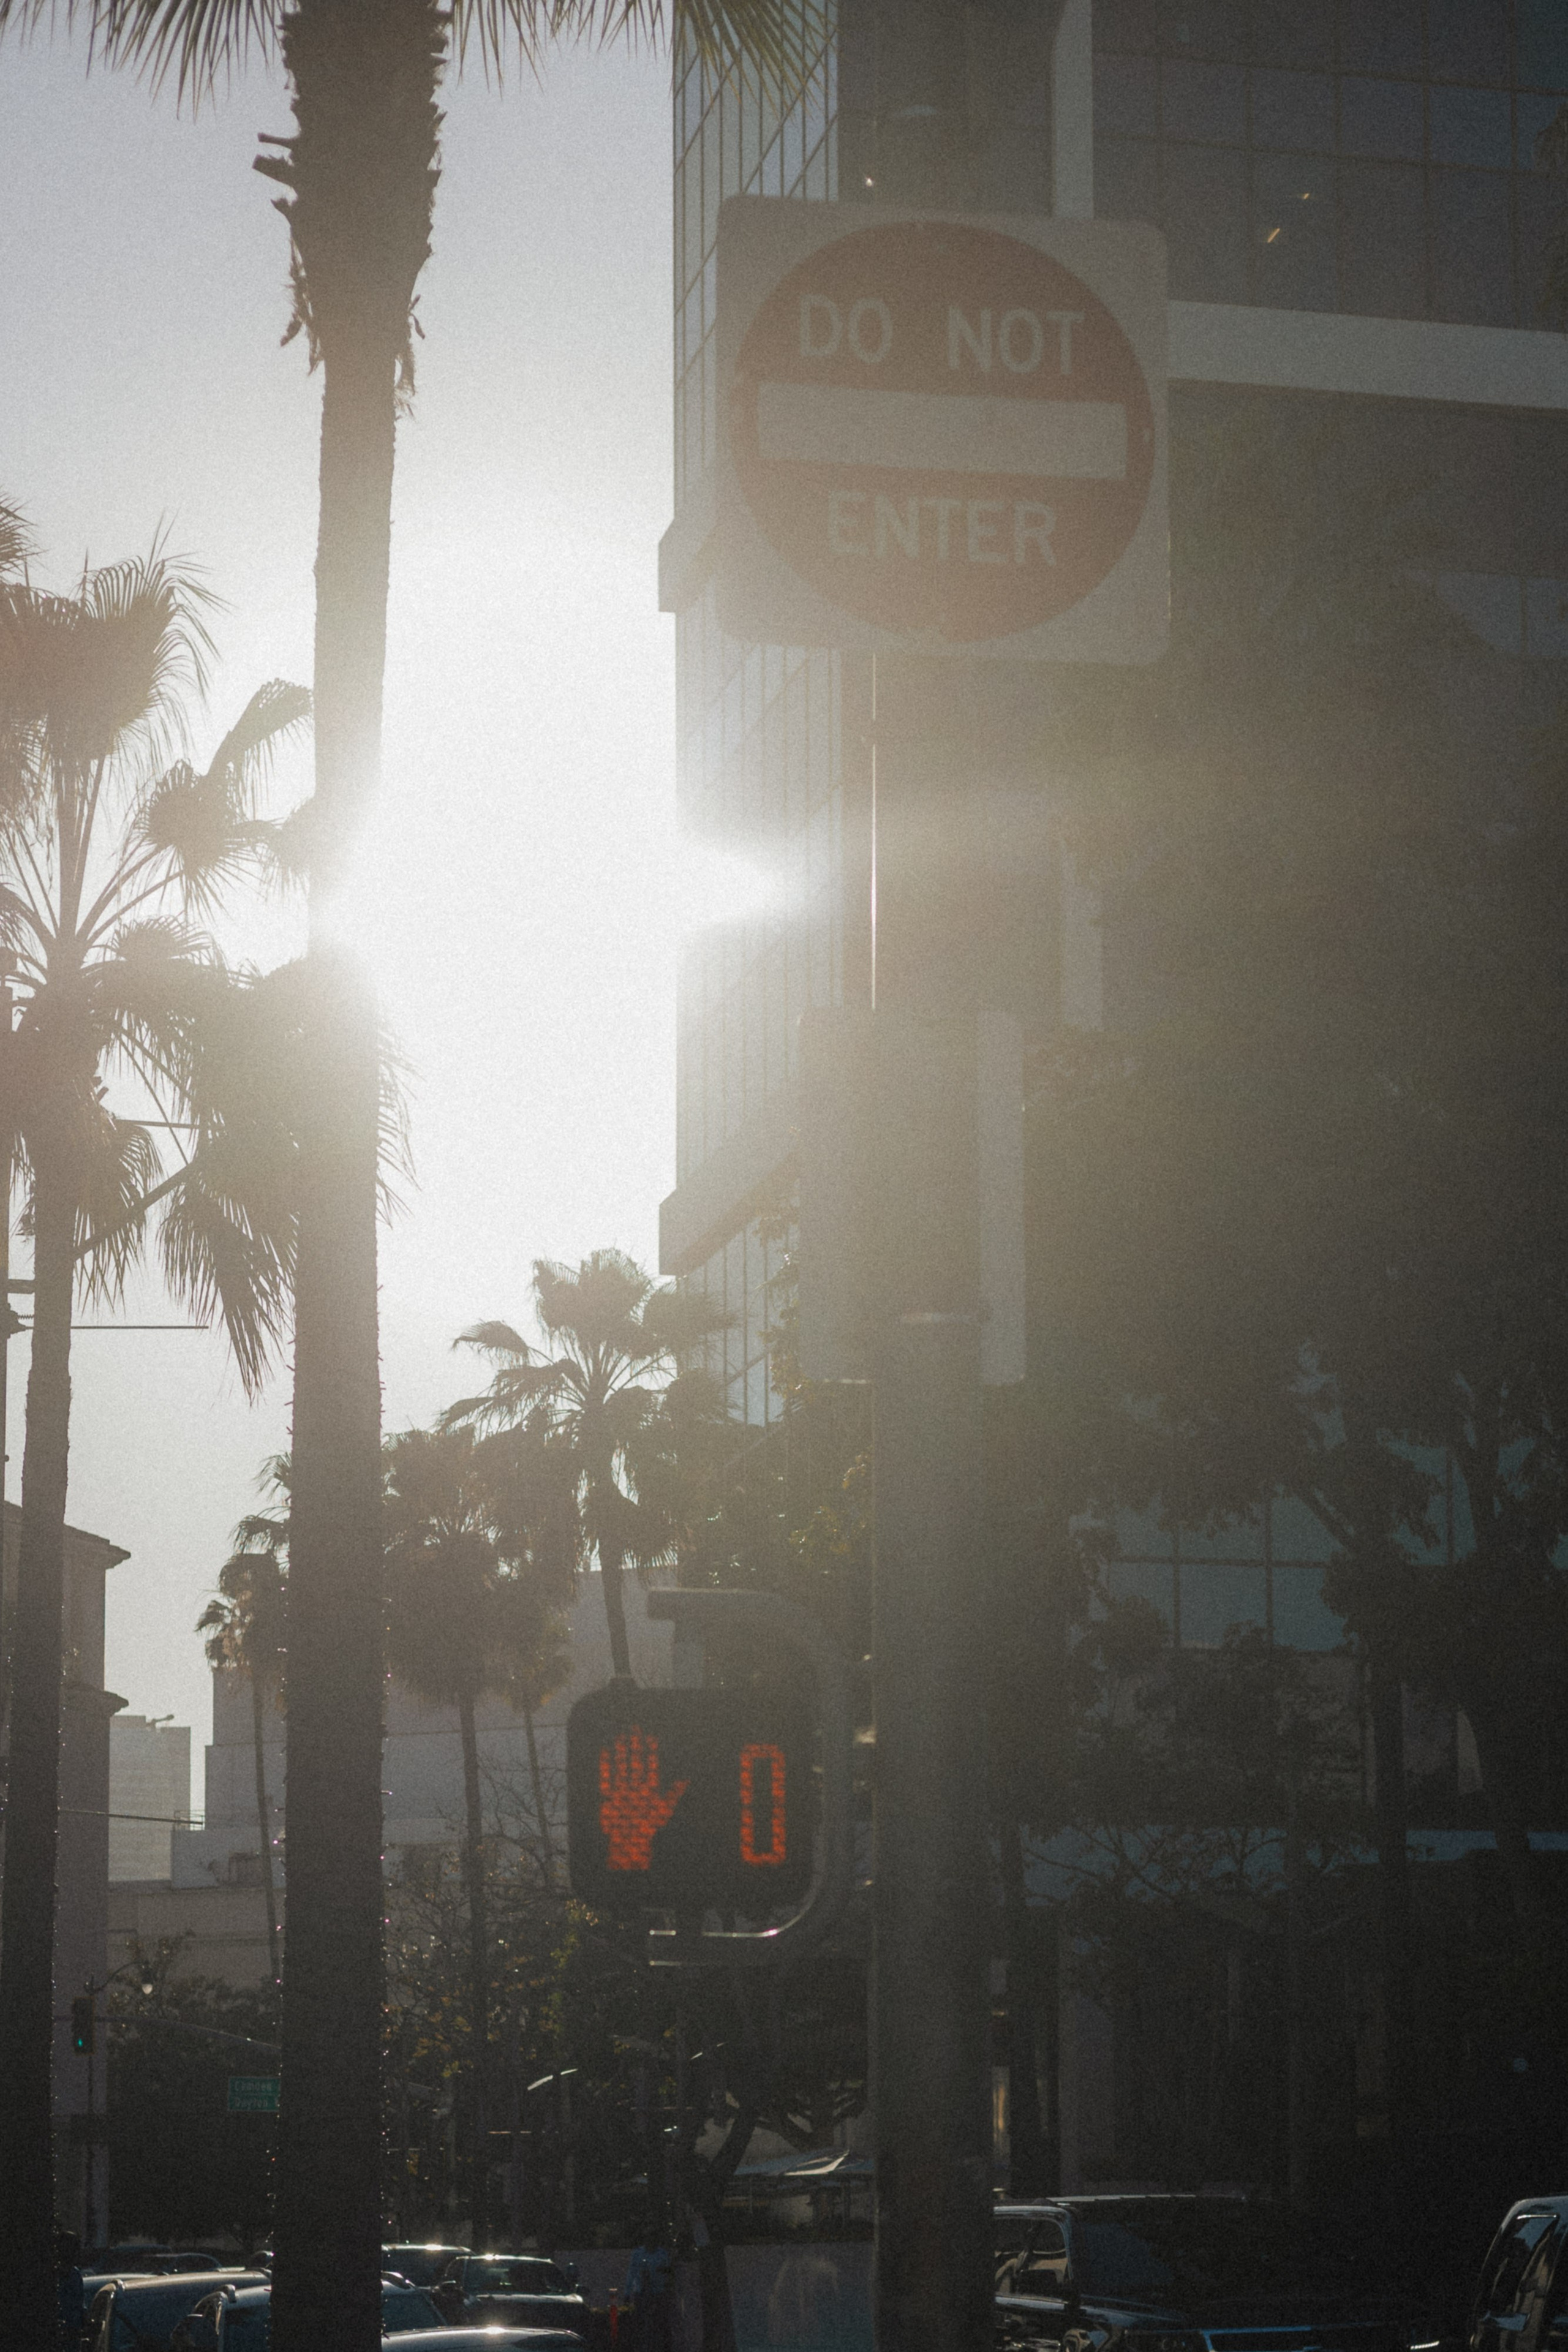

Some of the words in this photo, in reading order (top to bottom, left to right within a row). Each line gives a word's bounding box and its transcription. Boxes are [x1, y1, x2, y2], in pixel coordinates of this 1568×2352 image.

[799, 295, 893, 363] DO
[949, 306, 1084, 375] NOT
[827, 490, 1057, 566] ENTER
[741, 1744, 785, 1865] 0
[235, 2081, 272, 2091] Camden
